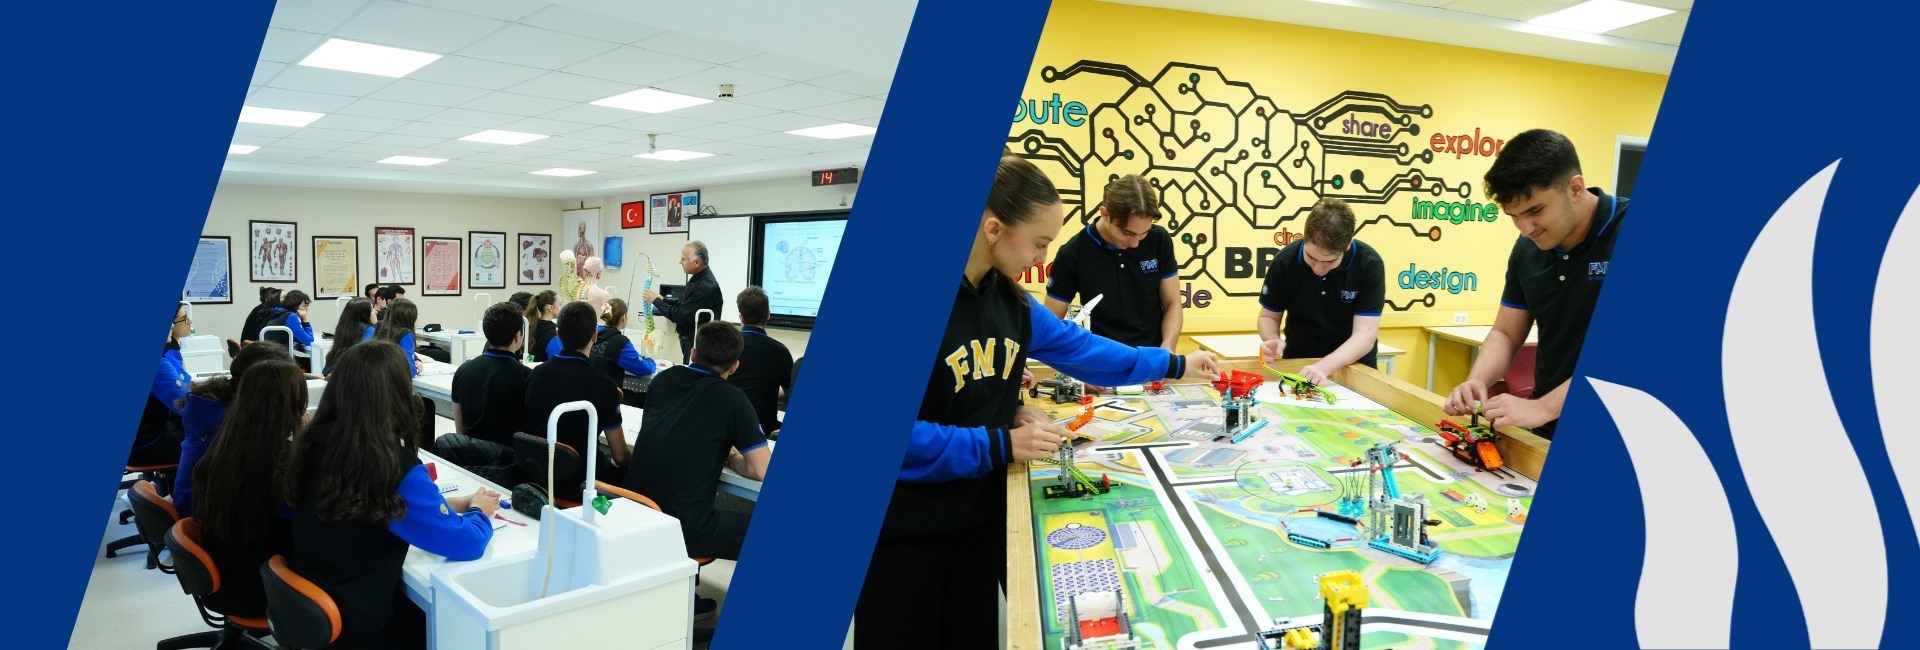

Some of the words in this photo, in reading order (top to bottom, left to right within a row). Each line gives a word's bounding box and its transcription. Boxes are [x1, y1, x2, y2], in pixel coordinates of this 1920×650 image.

[1342, 113, 1392, 139] share
[1412, 196, 1499, 225] imagine
[1398, 263, 1477, 294] design
[945, 337, 1021, 393] FMV
